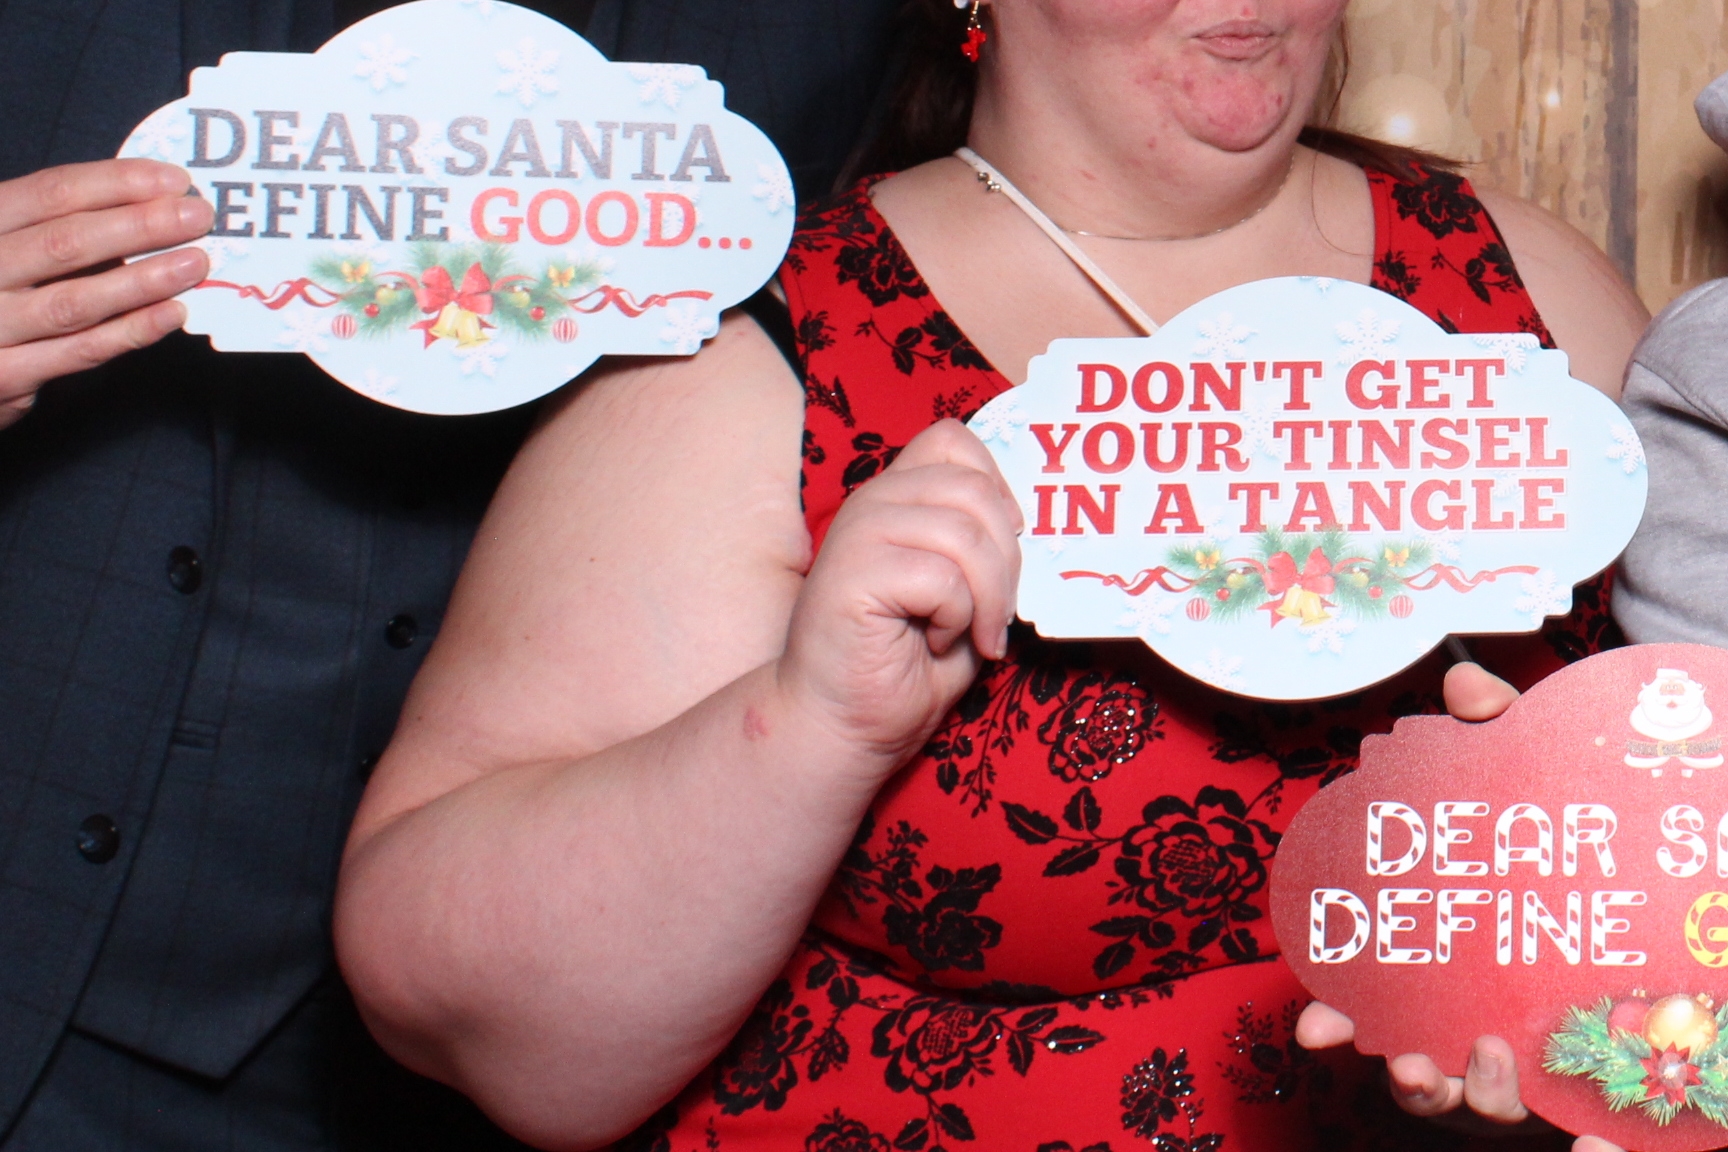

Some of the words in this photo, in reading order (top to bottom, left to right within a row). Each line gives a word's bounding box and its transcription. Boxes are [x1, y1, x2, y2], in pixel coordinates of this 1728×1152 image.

[186, 107, 423, 176] DEAR
[444, 115, 731, 182] SANTA
[191, 180, 450, 242] EFINE
[470, 187, 752, 250] GOOD...
[1075, 361, 1323, 414] DON'T
[1345, 358, 1506, 410] GET
[1030, 422, 1250, 474] YOUR
[1273, 417, 1569, 471] TINSEL
[1032, 484, 1121, 536] IN
[1144, 483, 1204, 535] A
[1229, 477, 1566, 534] TANGLE
[1365, 801, 1618, 877] DEAR
[1308, 888, 1648, 966] DEFINE
